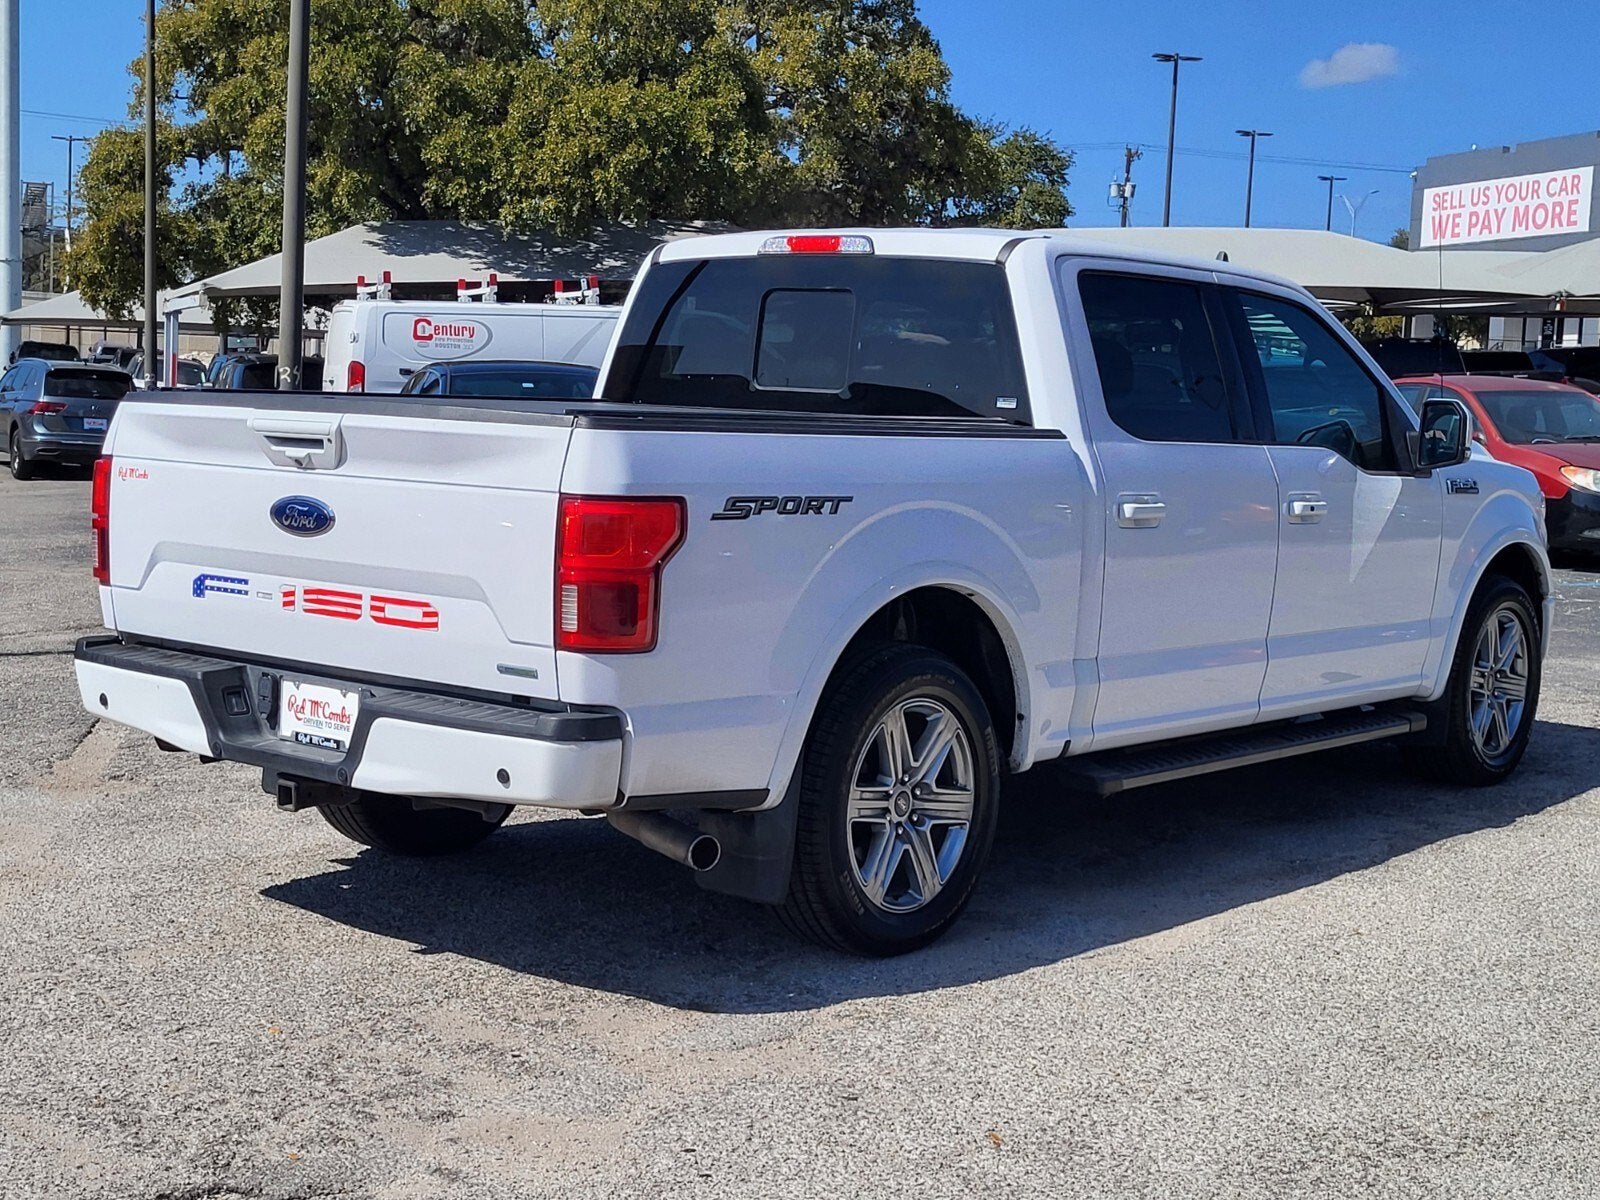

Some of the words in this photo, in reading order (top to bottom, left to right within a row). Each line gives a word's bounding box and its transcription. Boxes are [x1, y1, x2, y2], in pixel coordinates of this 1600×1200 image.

[1432, 191, 1466, 211] SELL
[1470, 186, 1491, 207] US
[1495, 180, 1541, 203] YOUR
[1546, 174, 1581, 198] CAR
[1431, 213, 1461, 240] WE
[1467, 207, 1507, 237] PAY
[1511, 199, 1579, 232] MORE
[413, 318, 475, 341] Century
[282, 504, 318, 529] Ford
[710, 496, 854, 521] SPORT
[287, 694, 307, 721] Red
[303, 717, 324, 728] DRIVEN
[333, 724, 351, 733] SERVE
